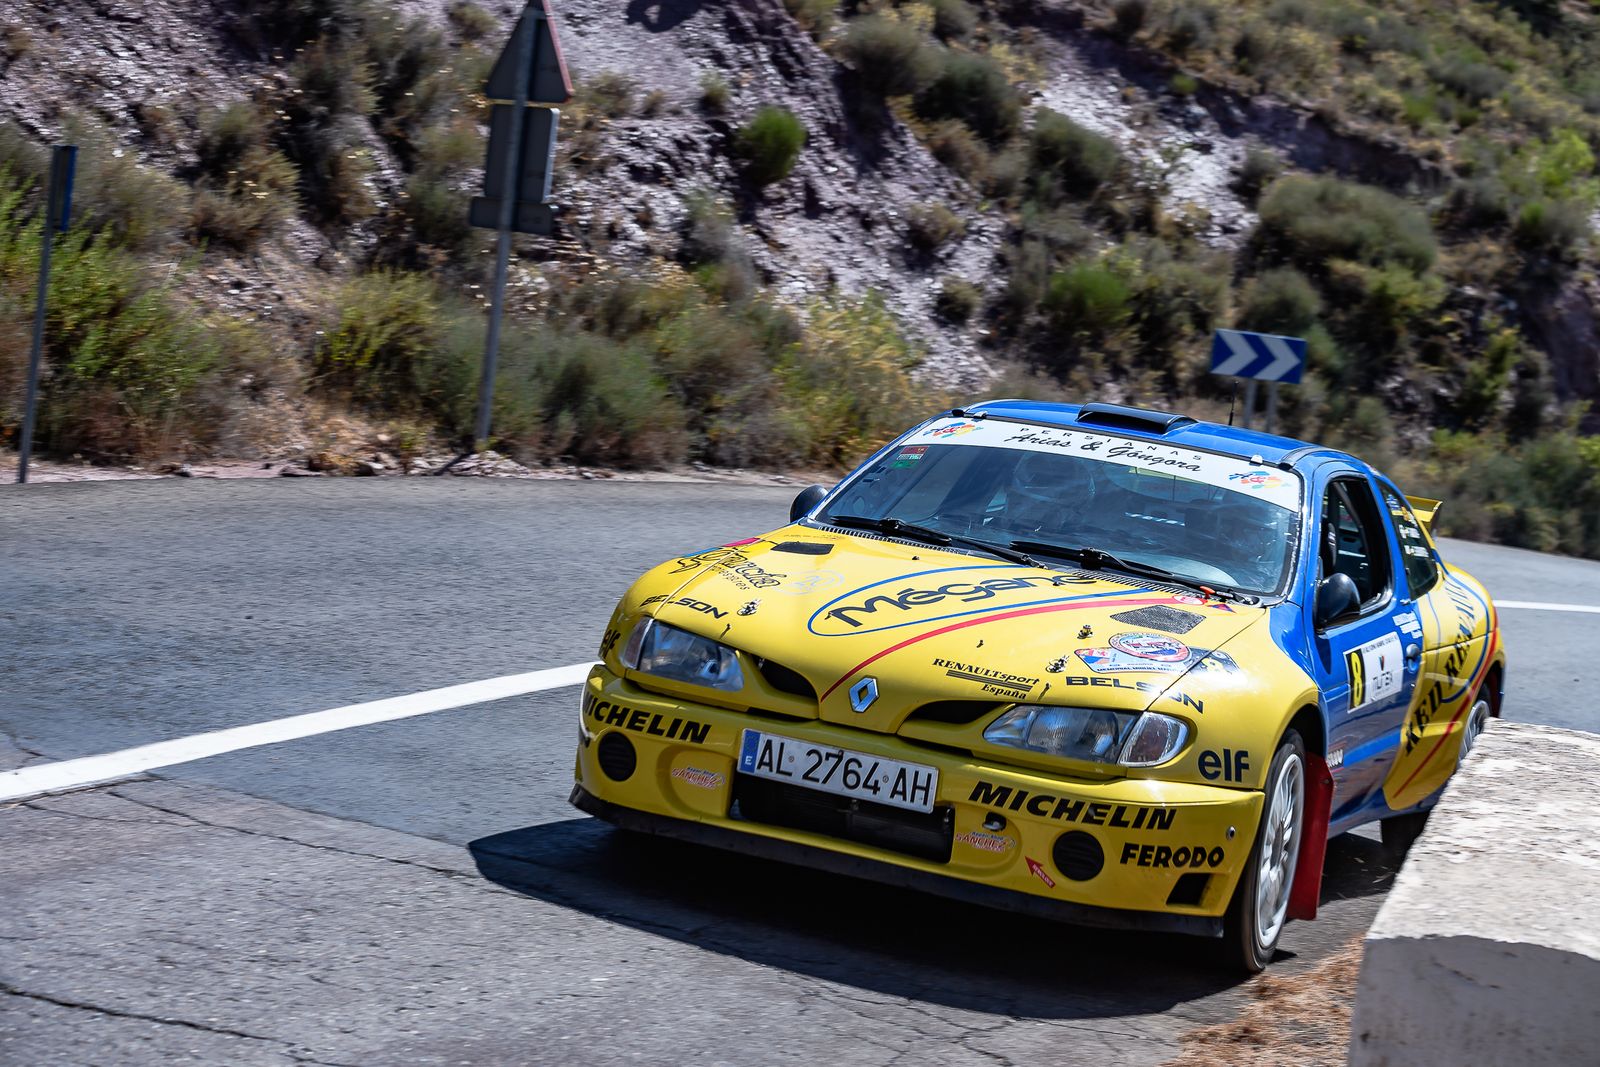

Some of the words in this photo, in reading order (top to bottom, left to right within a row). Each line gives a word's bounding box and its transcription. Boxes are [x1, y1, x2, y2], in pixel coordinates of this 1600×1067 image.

[1004, 433, 1071, 448] Arias
[1080, 440, 1103, 451] &
[1020, 427, 1202, 461] PERSIANAS
[829, 574, 1097, 628] Mégane
[981, 683, 1027, 700] España
[1350, 652, 1363, 707] 8
[744, 755, 754, 766] E
[756, 739, 793, 777] AL
[801, 749, 881, 796] 2764
[889, 767, 932, 806] AH
[1197, 748, 1250, 782] elf
[968, 780, 1177, 830] MICHELIN
[1119, 842, 1225, 868] FERODO
